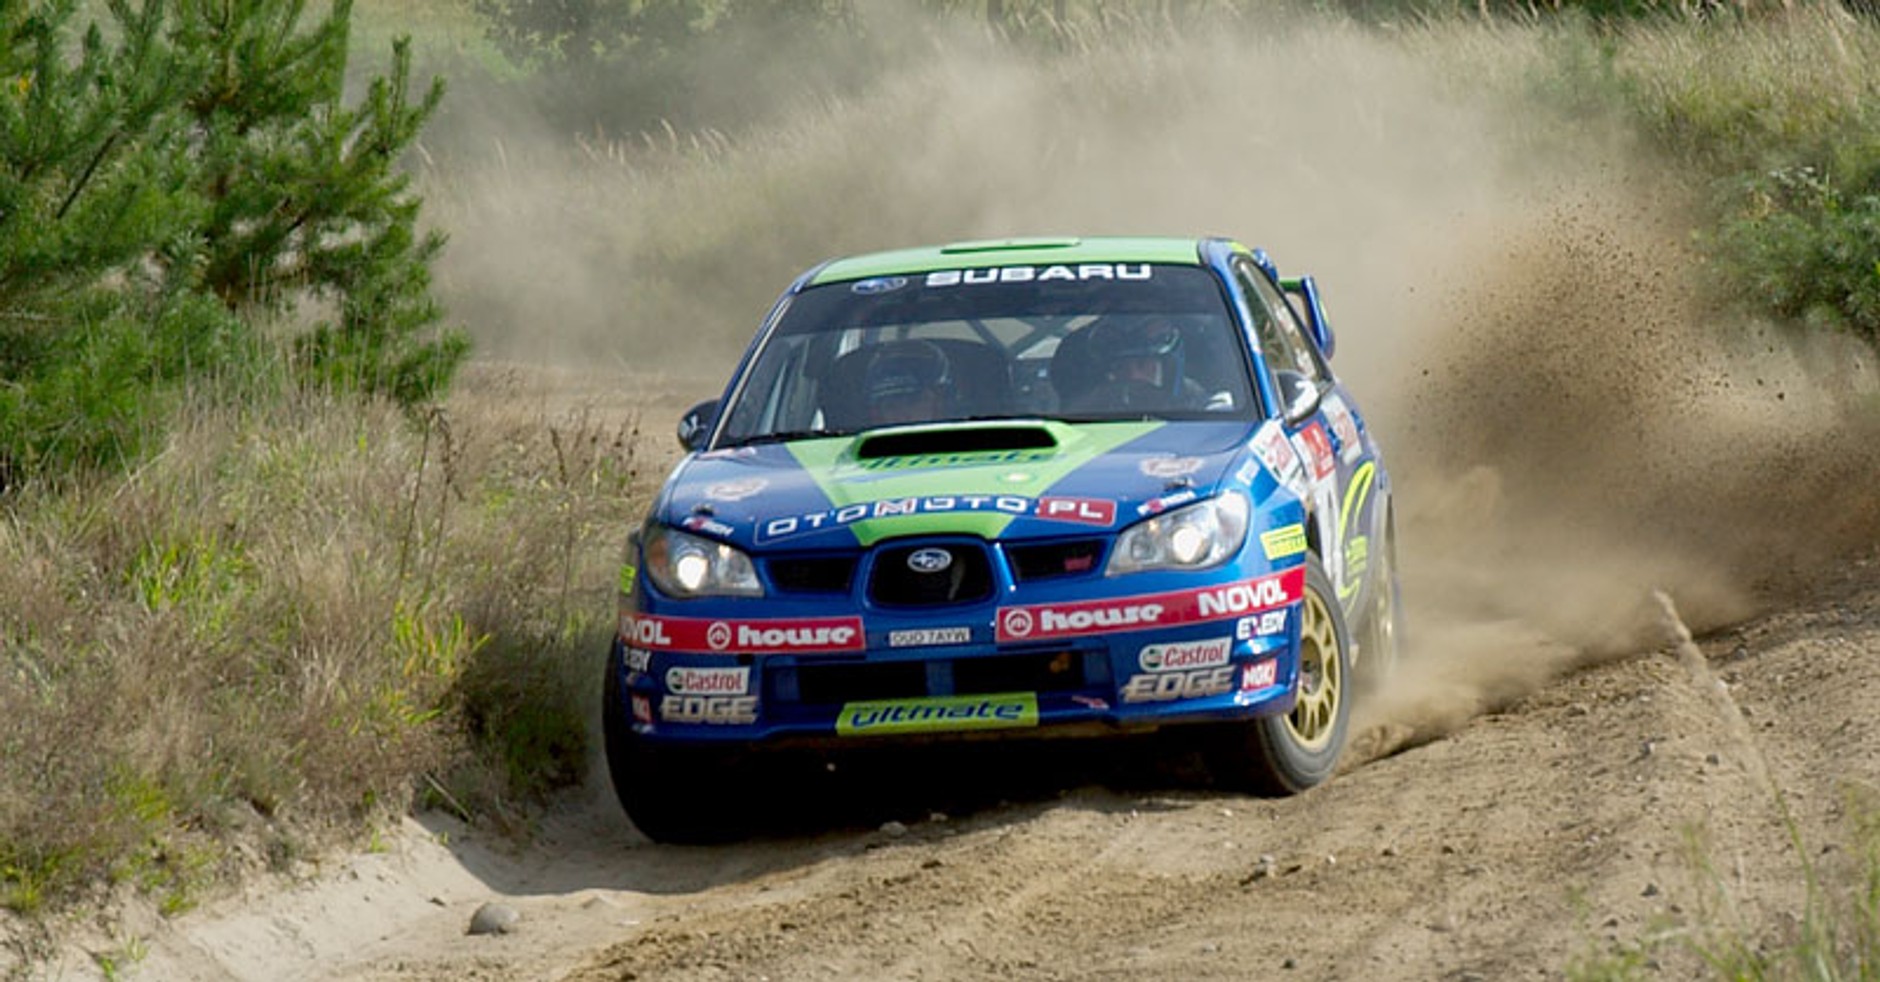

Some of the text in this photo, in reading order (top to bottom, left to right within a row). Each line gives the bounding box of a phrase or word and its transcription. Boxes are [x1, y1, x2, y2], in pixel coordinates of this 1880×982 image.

[926, 263, 1152, 286] SUBARU
[1198, 578, 1288, 616] NOVOL
[1040, 603, 1164, 632] house
[737, 625, 856, 646] house
[1164, 643, 1226, 668] Castrol
[685, 670, 743, 692] Castrol
[1122, 665, 1238, 703] EDGE
[660, 695, 759, 724] EDGE
